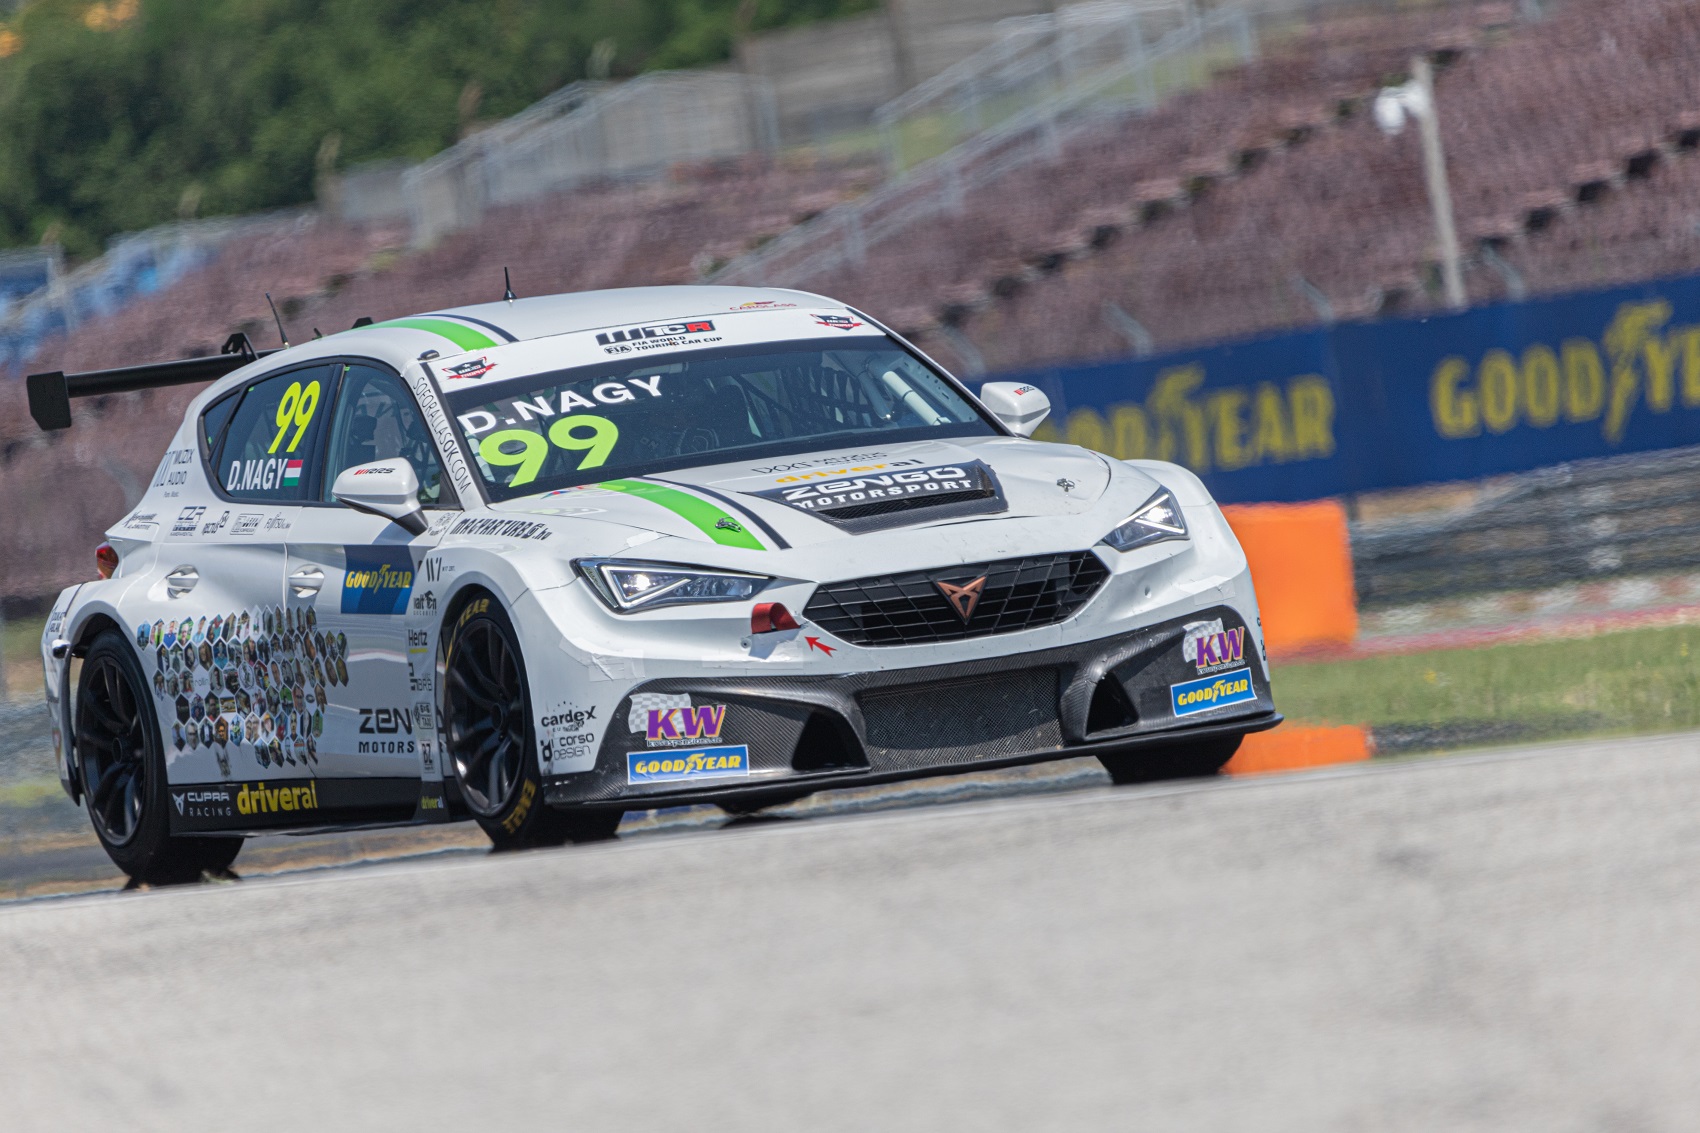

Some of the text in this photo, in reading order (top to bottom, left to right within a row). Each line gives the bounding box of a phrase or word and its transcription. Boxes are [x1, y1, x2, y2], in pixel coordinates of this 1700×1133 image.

[636, 341, 678, 351] TOURING
[651, 336, 686, 345] WORLD
[267, 381, 320, 454] 99
[456, 375, 662, 434] D.NAGY
[412, 376, 472, 495] SOFORALLASOK.COM
[479, 414, 619, 488] 99
[226, 458, 288, 490] D.NAGY
[775, 458, 924, 483] driveral
[782, 466, 967, 501] ZENGO
[793, 479, 973, 508] MOTORSPORT
[408, 629, 428, 646] Hertz
[1196, 626, 1245, 668] KW
[541, 705, 597, 728] cardex
[645, 704, 726, 740] KW
[559, 733, 595, 747] corso
[187, 792, 230, 802] CUPRA
[189, 807, 232, 817] RACING
[236, 780, 318, 815] driveral
